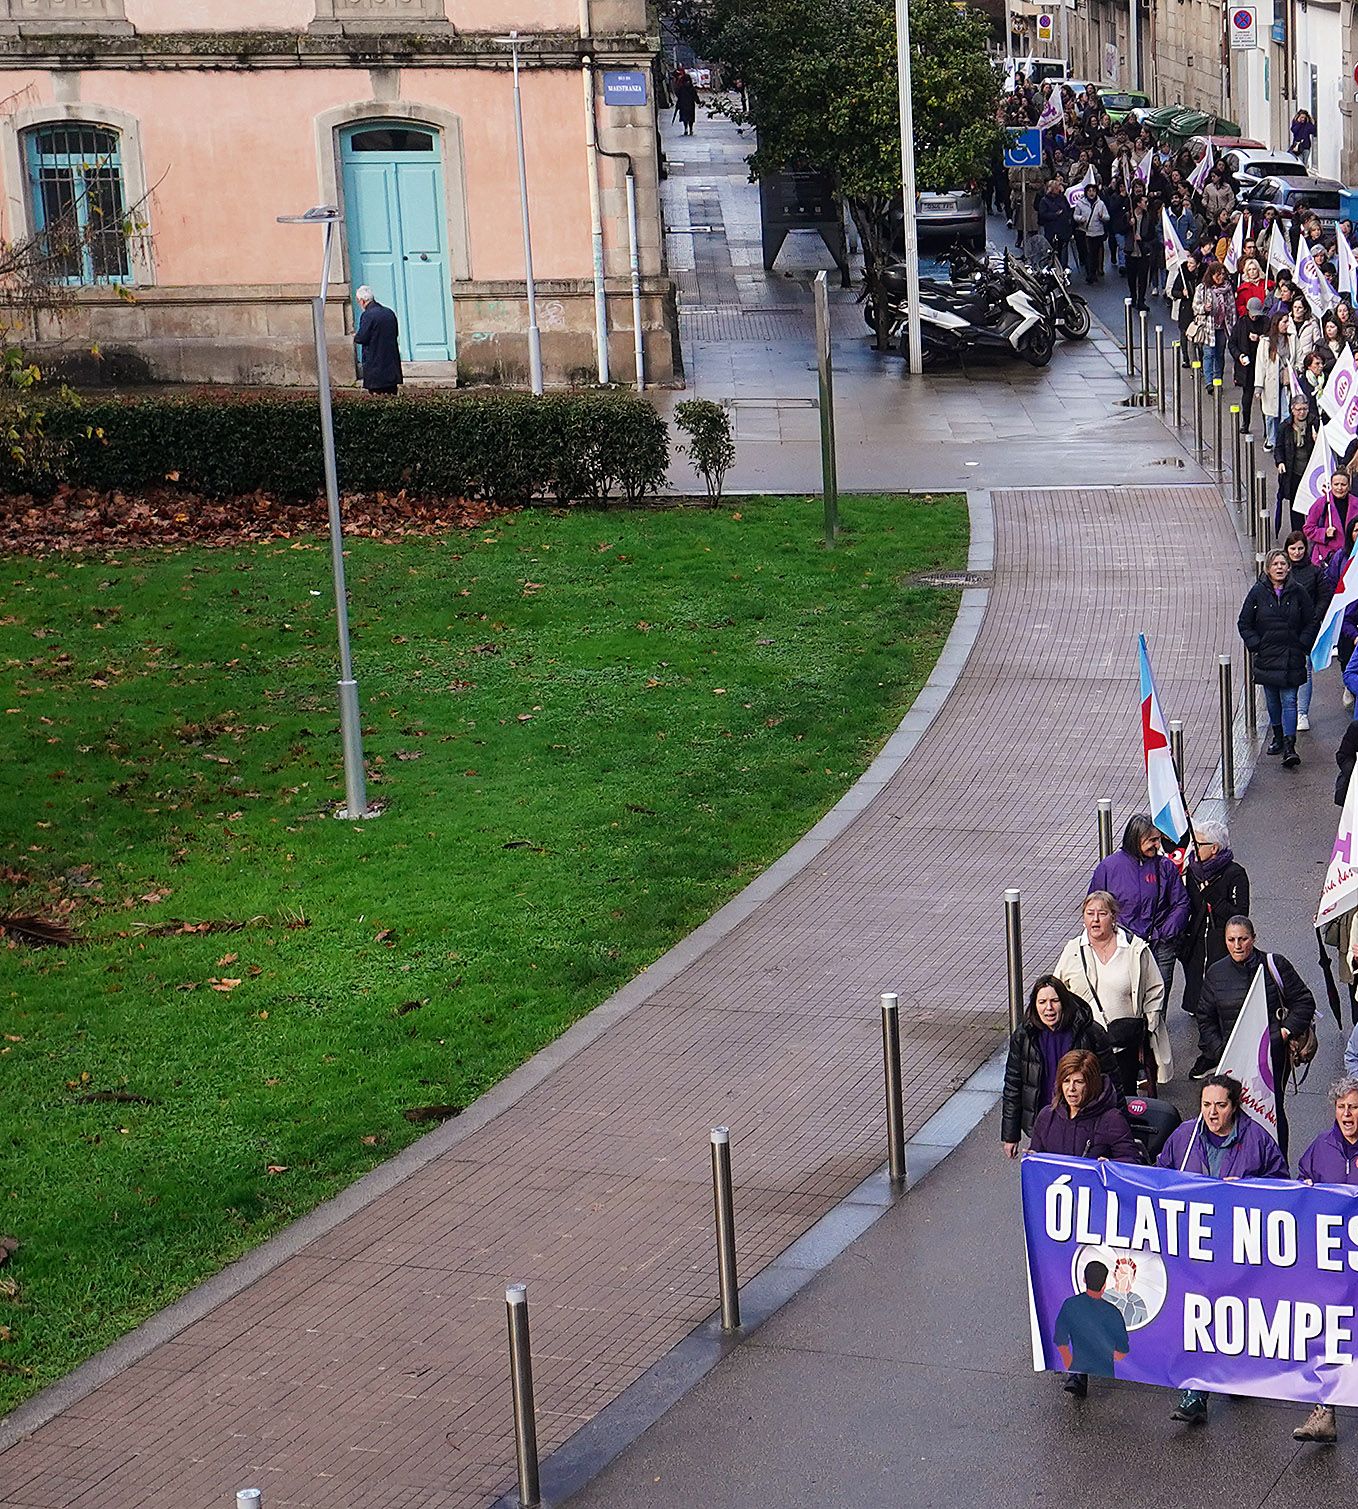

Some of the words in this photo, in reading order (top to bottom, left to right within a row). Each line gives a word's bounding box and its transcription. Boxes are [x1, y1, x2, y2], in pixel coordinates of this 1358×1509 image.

[1045, 1174, 1215, 1263] ÓLLATE
[1232, 1206, 1298, 1267] NO
[1183, 1292, 1354, 1365] ROMPE
